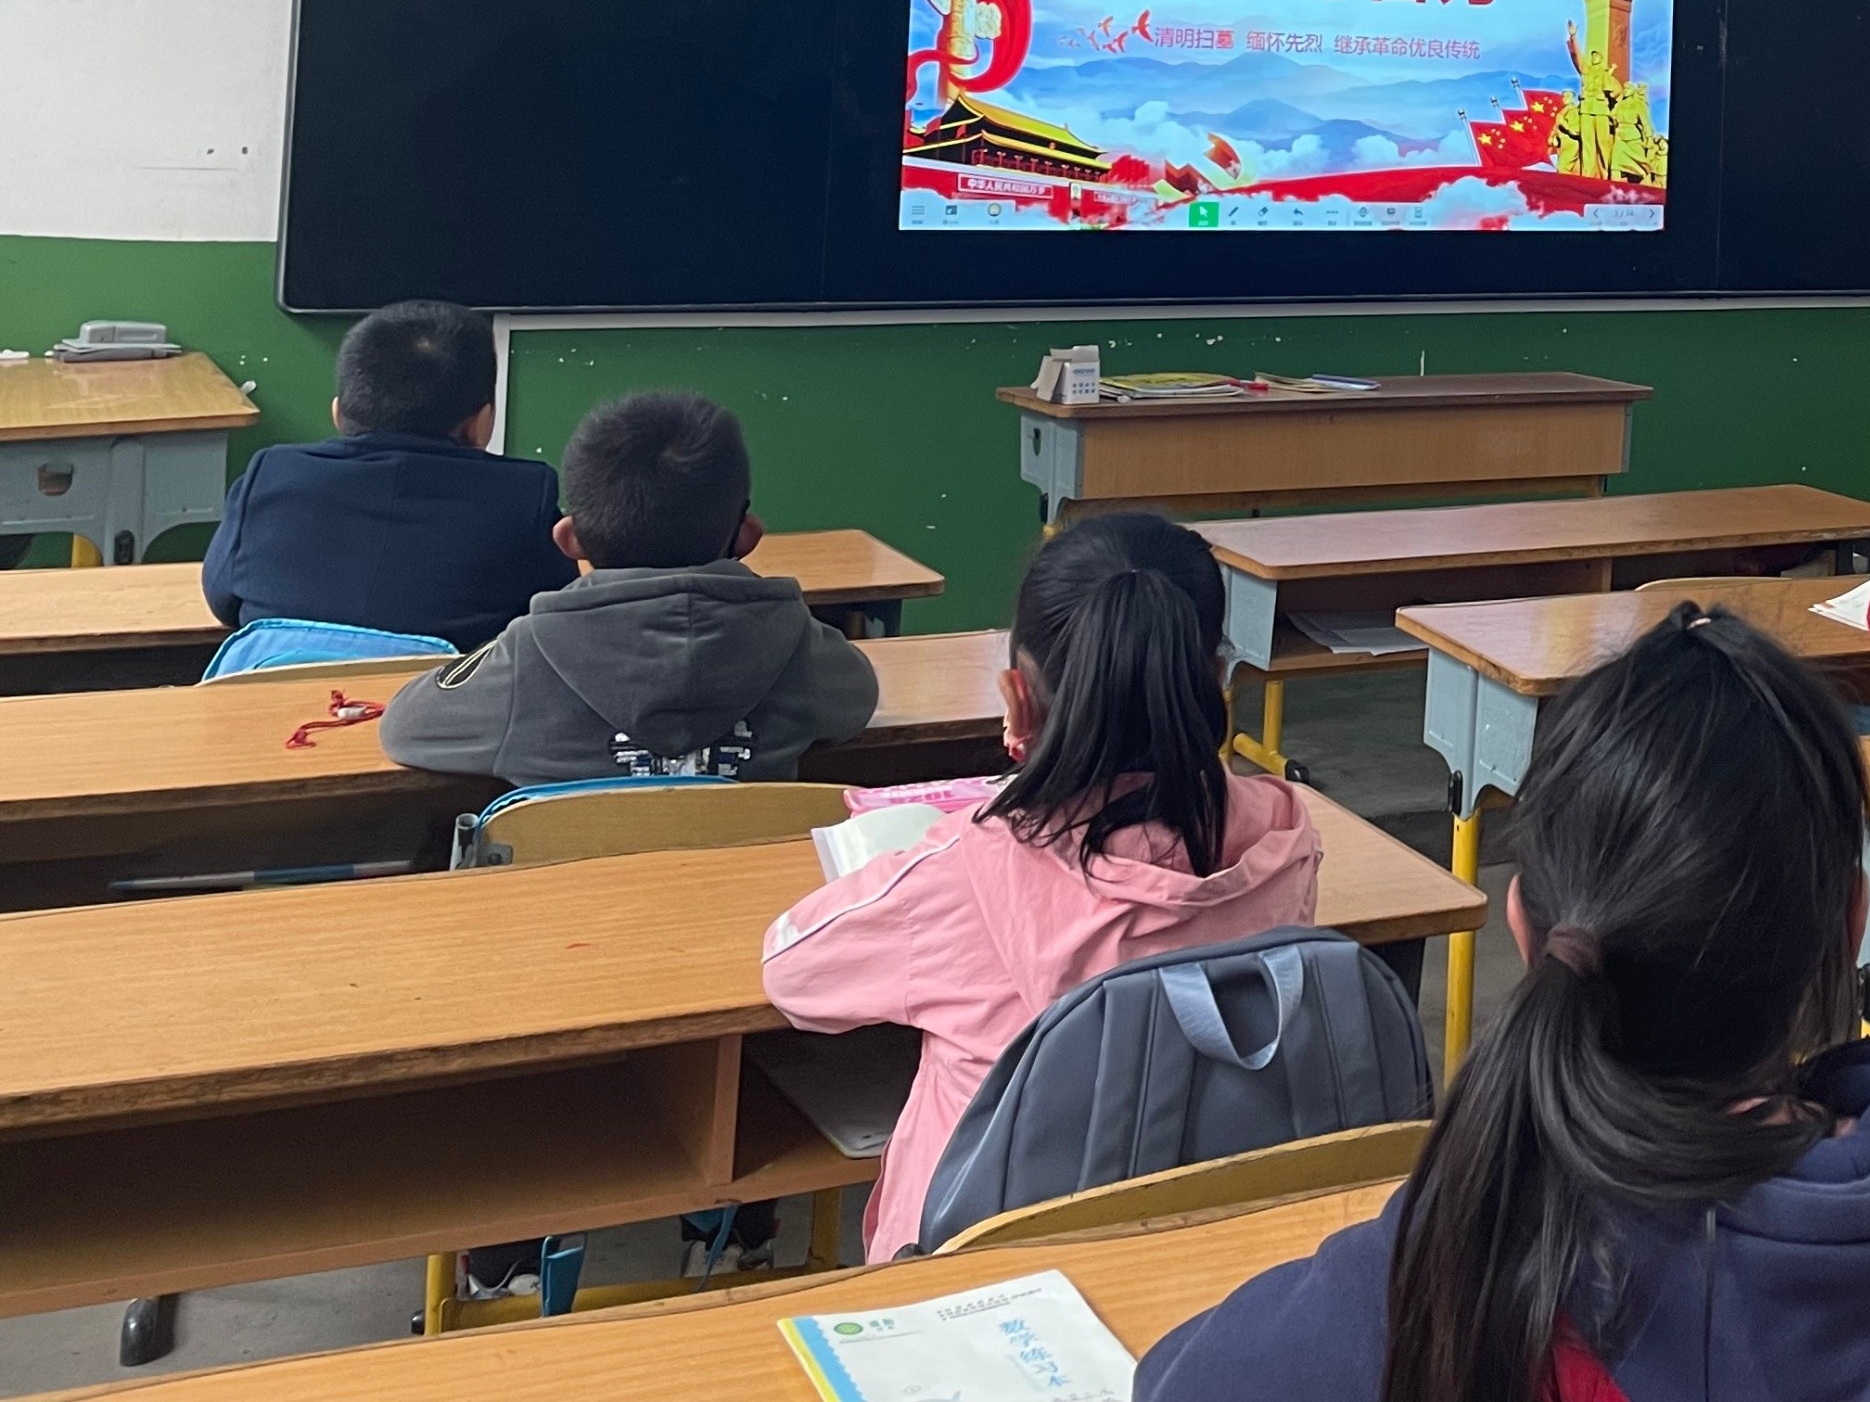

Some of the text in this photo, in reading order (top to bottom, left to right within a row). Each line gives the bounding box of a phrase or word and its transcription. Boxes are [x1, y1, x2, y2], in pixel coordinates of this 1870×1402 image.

[1154, 26, 1481, 60] 清明扫墓 缅怀先烈 继承革命优良传统
